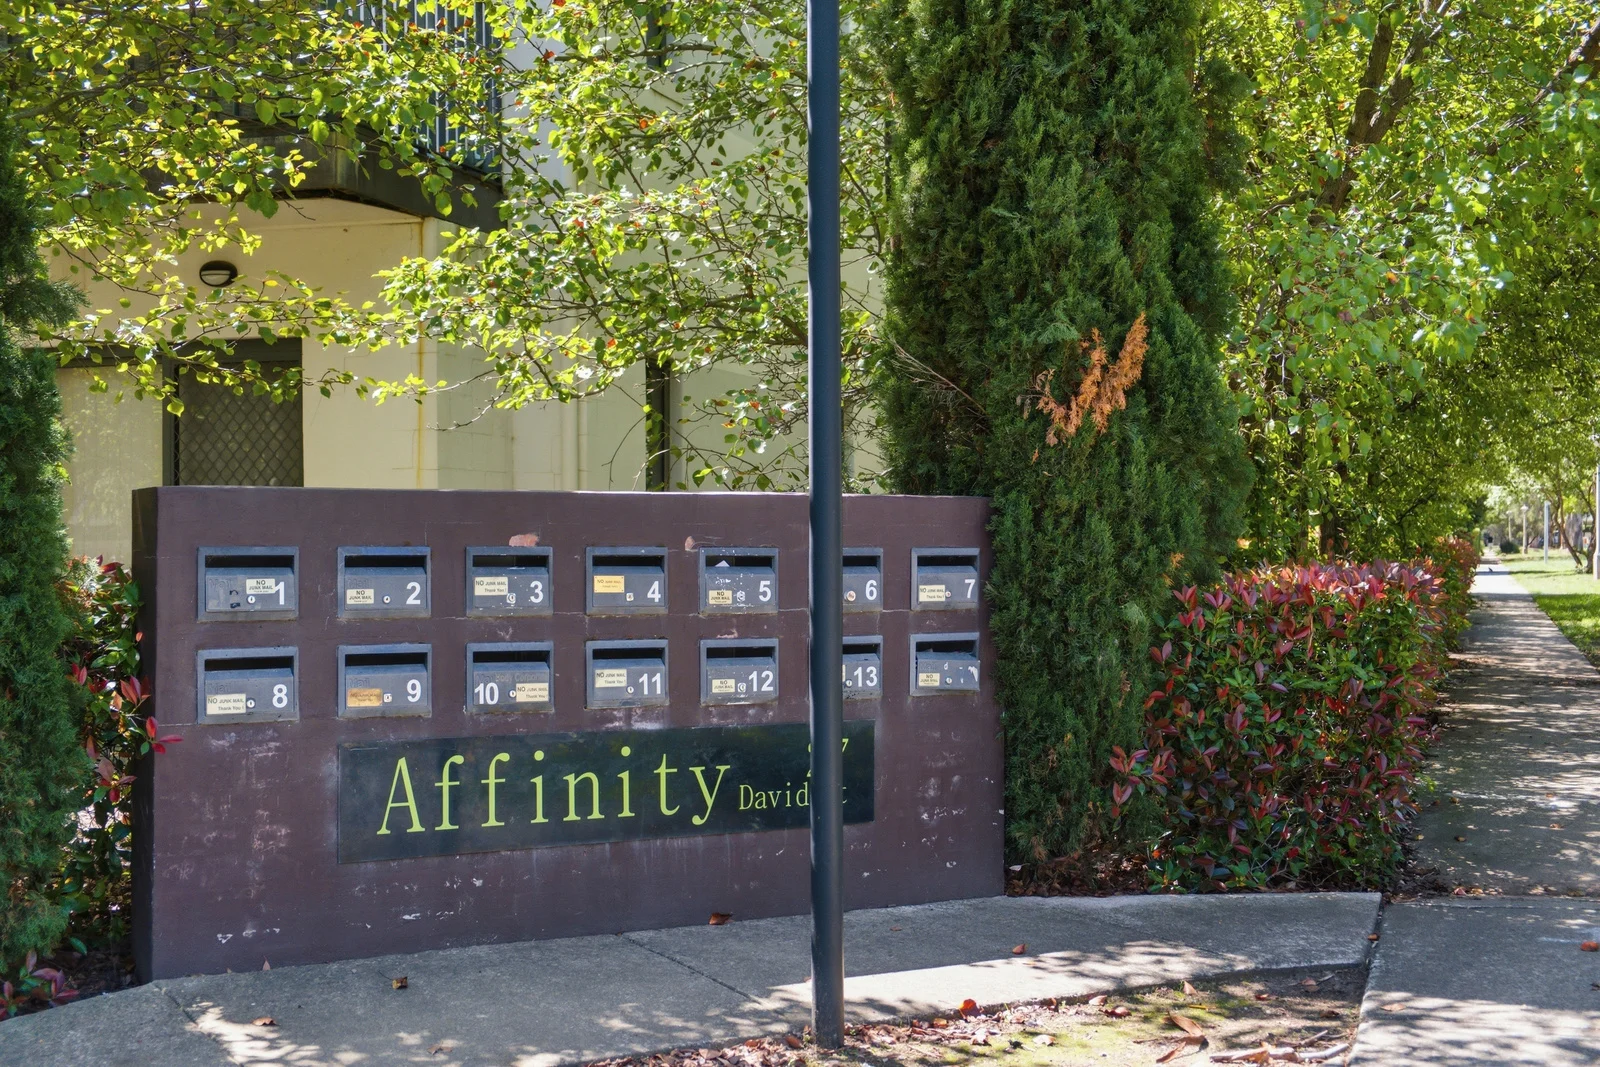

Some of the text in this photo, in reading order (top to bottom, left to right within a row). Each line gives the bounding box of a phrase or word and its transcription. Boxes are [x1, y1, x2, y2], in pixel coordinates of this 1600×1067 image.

[274, 582, 284, 605] 1
[406, 582, 420, 604] 2
[530, 581, 544, 603] 3
[647, 581, 661, 602] 4
[759, 581, 771, 602] 5
[866, 580, 877, 600] 6
[965, 579, 976, 598] 7
[639, 673, 661, 695] 11
[748, 670, 774, 691] 12
[854, 666, 877, 687] 13
[272, 684, 288, 708] 8
[407, 679, 421, 702] 9
[474, 682, 499, 705] 10
[376, 746, 730, 834] Affinity
[739, 782, 810, 810] David
